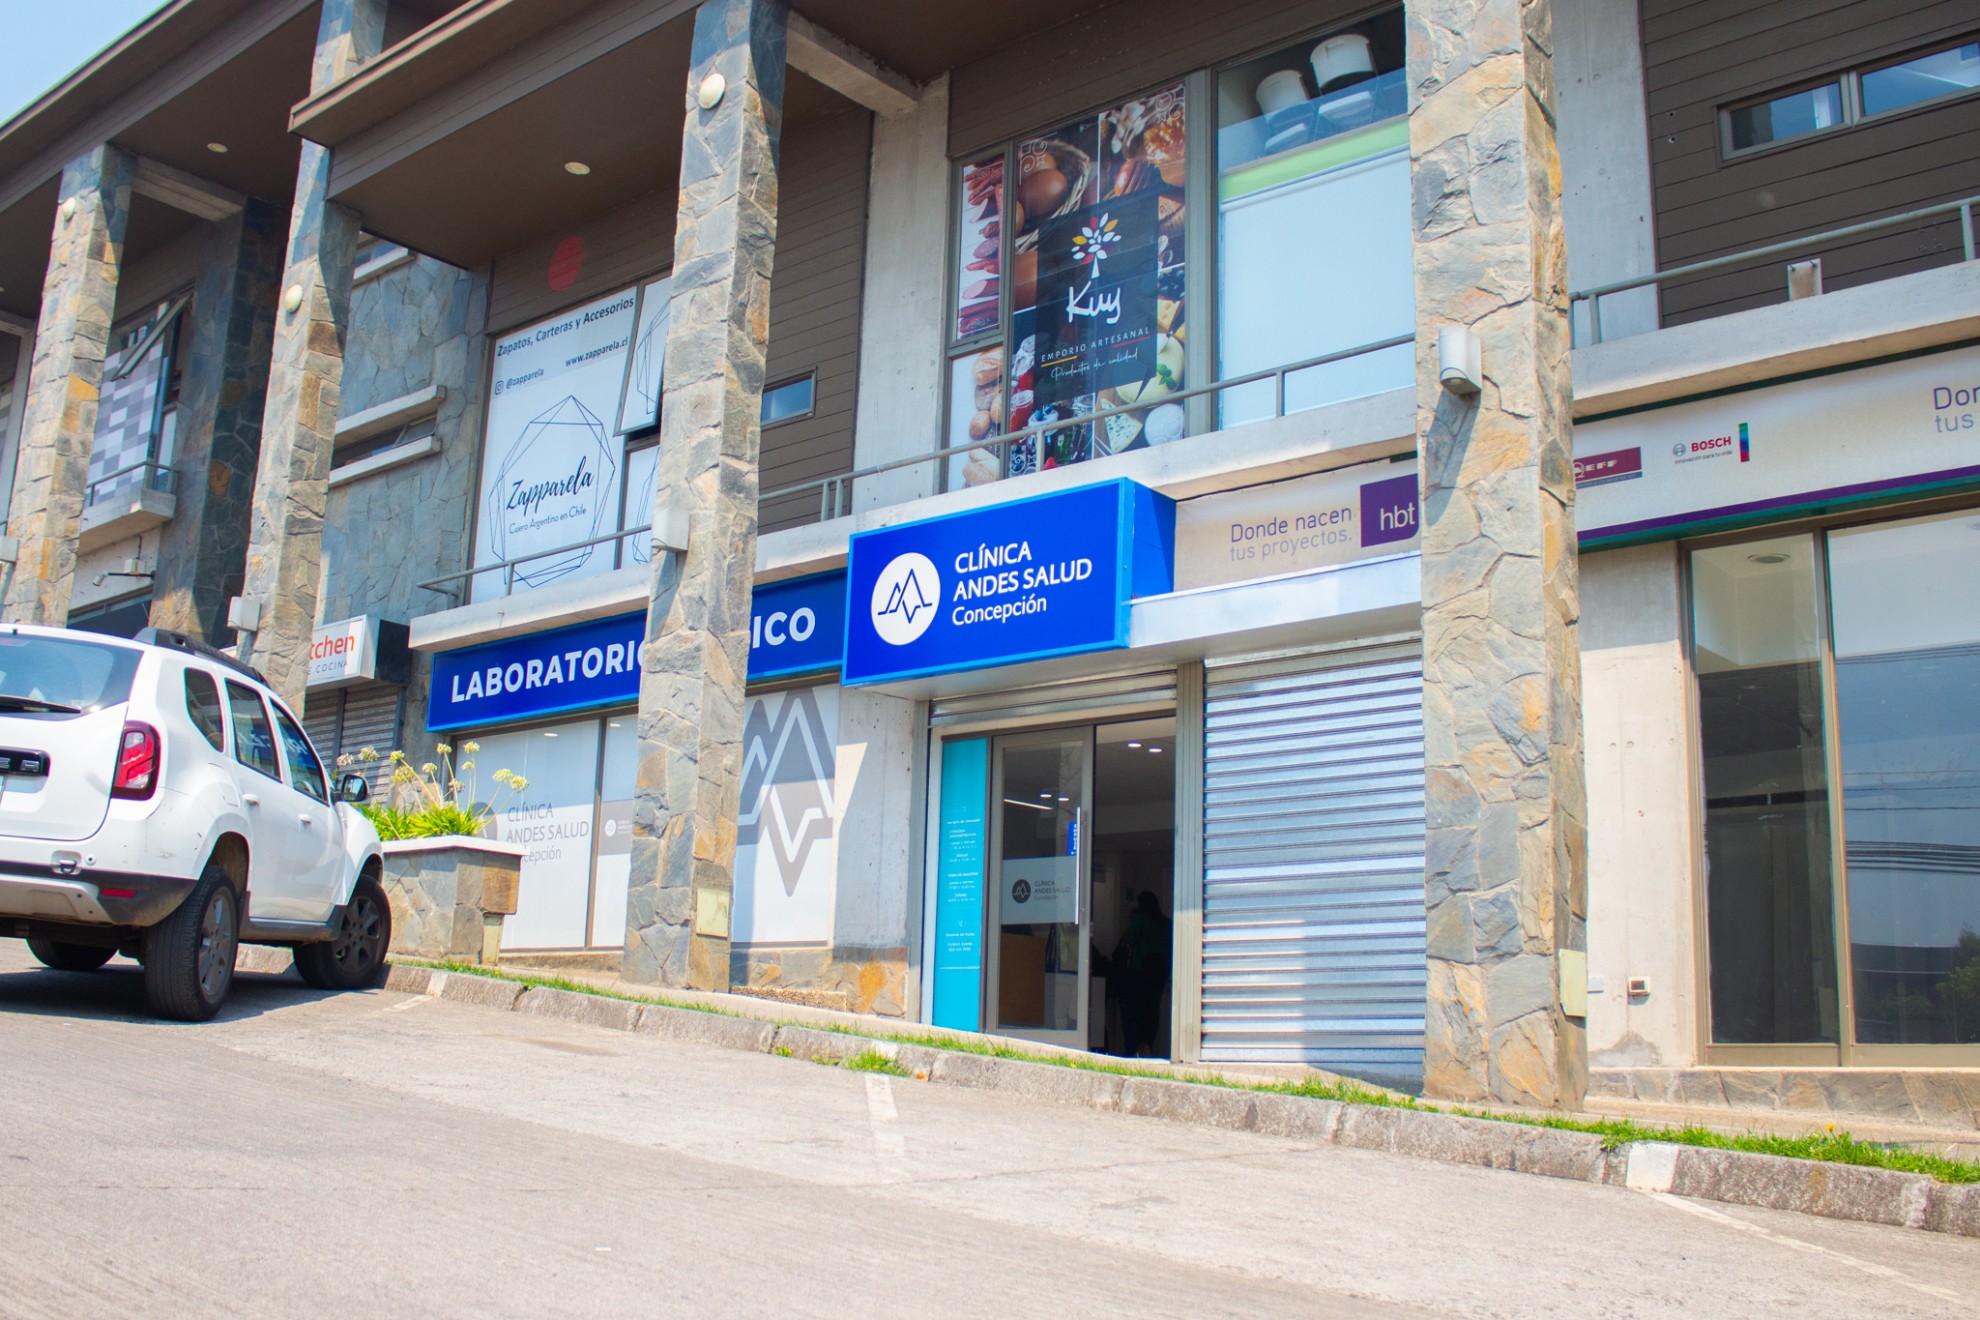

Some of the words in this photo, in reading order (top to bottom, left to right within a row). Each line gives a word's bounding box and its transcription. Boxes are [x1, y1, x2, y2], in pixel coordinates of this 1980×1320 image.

[1066, 280, 1121, 324] Kuy
[497, 336, 534, 357] Zapatos,
[535, 321, 573, 342] Carteras
[575, 318, 582, 330] y
[583, 297, 635, 325] Accesorios
[565, 336, 629, 367] www.zapparela.cl
[1041, 344, 1087, 363] EMPORIO
[1091, 326, 1150, 349] ARTESANAL
[505, 367, 545, 390] @zapparela
[1934, 413, 1975, 433] tus
[1690, 435, 1732, 453] BOSCH
[506, 455, 595, 517] Zapparela
[508, 522, 529, 535] Cuero
[529, 514, 559, 530] Argentino
[559, 512, 568, 521] en
[569, 503, 587, 518] Chile
[1231, 517, 1289, 543] Donde
[1295, 507, 1352, 531] nacen
[1380, 502, 1416, 531] hbt
[954, 540, 1032, 574] CLÍNICA
[1230, 545, 1256, 562] tus
[1262, 528, 1353, 561] proyectos.
[953, 571, 1019, 602] ANDES
[1023, 558, 1093, 590] SALUD
[952, 593, 1047, 626] Concepción
[752, 606, 816, 649] ICO
[308, 634, 355, 661] tchen
[452, 640, 645, 704] LABORATORI
[507, 801, 554, 822] CLÍNICA
[506, 826, 545, 844] ANDES
[547, 821, 590, 841] SALUD
[524, 844, 562, 866] cepción
